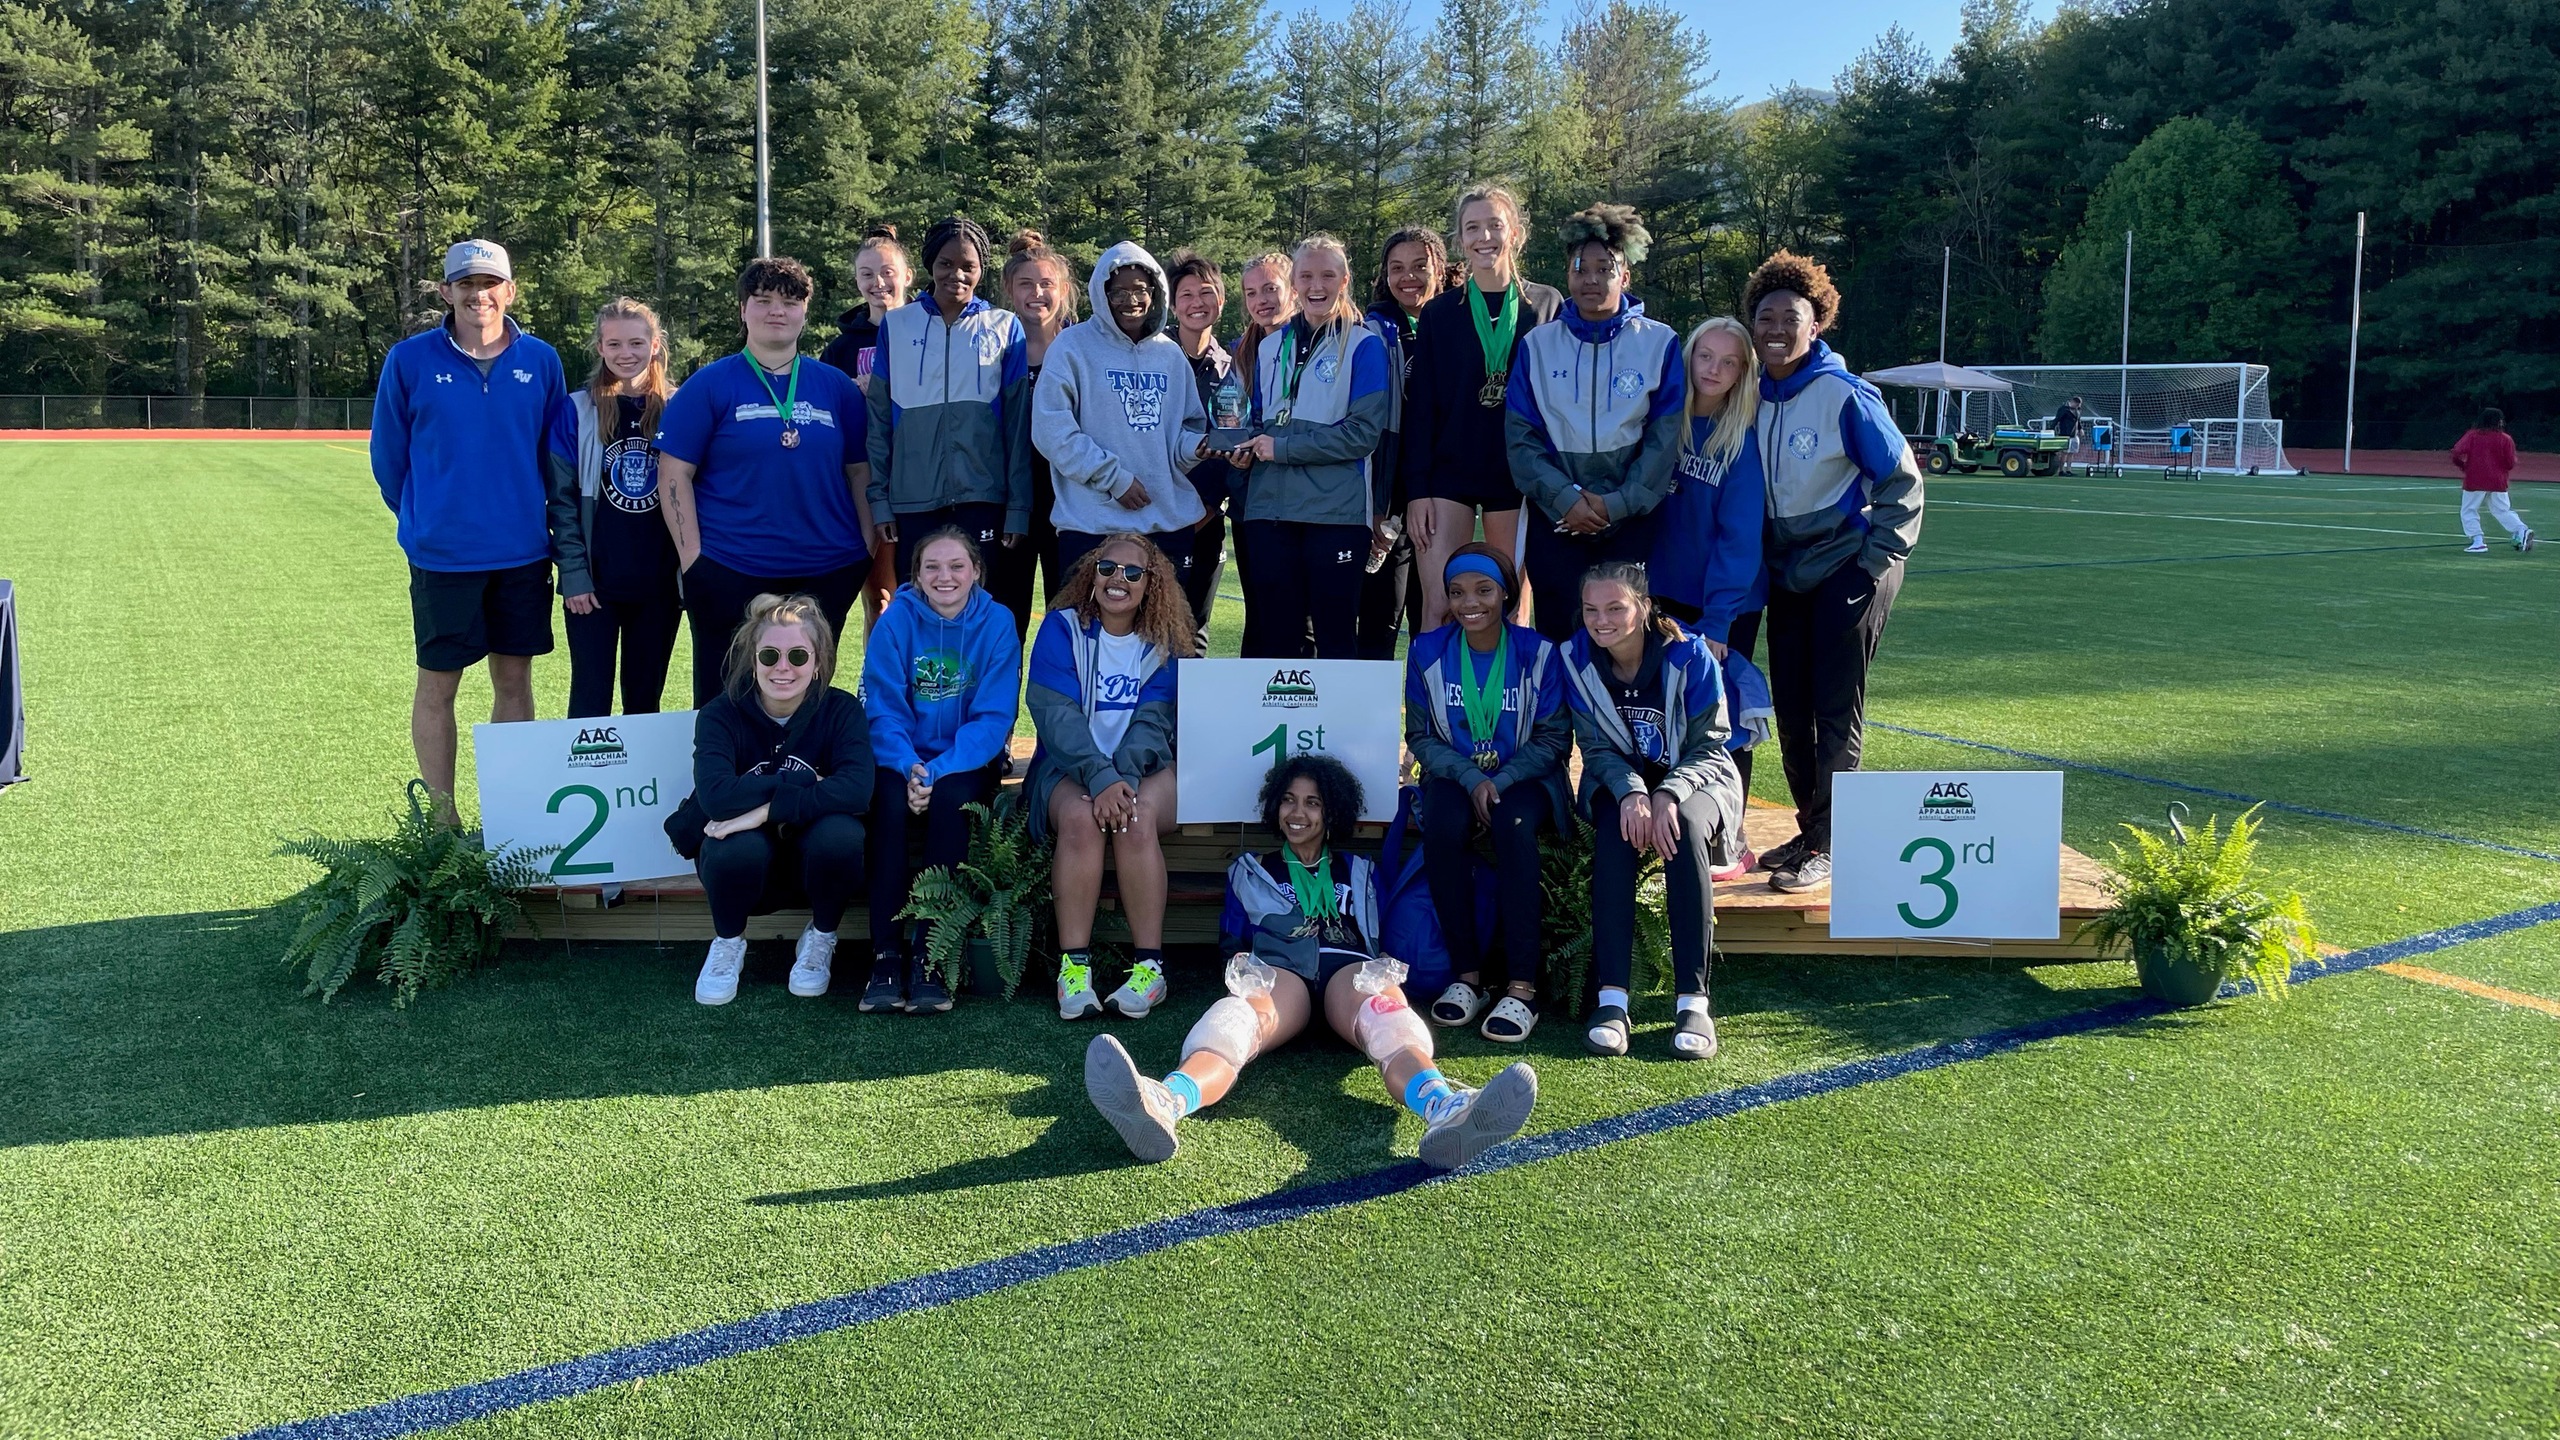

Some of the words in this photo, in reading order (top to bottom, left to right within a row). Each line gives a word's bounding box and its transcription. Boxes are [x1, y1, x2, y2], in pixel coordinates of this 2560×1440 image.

[513, 369, 533, 383] TW
[1105, 370, 1168, 394] TWU
[606, 484, 660, 510] TRACKDOG
[1273, 669, 1311, 686] AAC
[578, 727, 618, 744] AAC
[1252, 723, 1326, 769] 1st
[567, 751, 628, 763] APPALACHIAN
[1930, 782, 1968, 799] AAC
[546, 777, 659, 877] 2nd
[1897, 836, 1994, 930] 3rd
